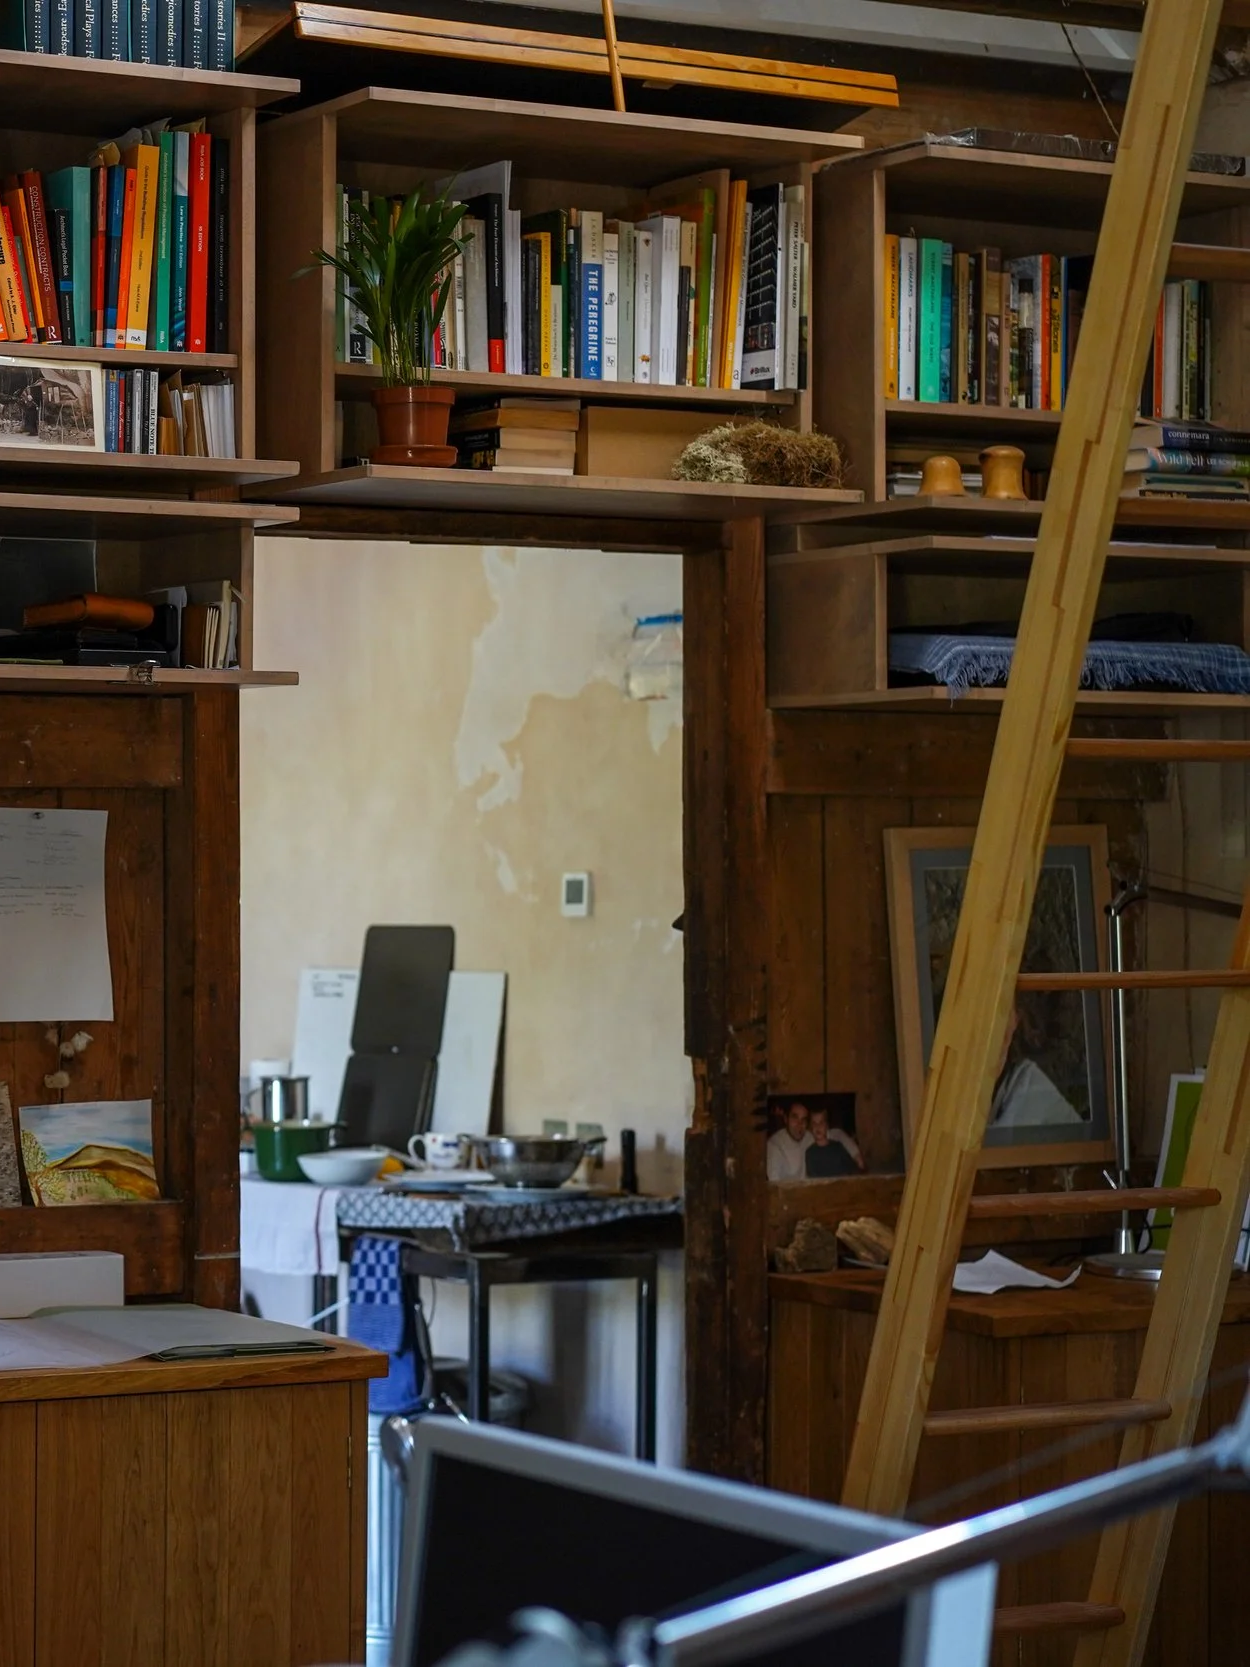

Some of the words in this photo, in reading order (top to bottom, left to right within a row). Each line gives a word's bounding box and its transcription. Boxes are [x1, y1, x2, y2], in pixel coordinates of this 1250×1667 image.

[110, 0, 118, 23] ances
[140, 0, 150, 22] edies
[192, 0, 201, 26] tories
[56, 17, 69, 56] kespeare
[81, 13, 95, 38] Plays
[217, 31, 226, 41] II
[59, 215, 67, 238] Architect's
[30, 184, 45, 245] CONSTRUCTION
[38, 245, 51, 292] CONTRACTS
[59, 237, 68, 249] Legal
[61, 249, 69, 264] Pocket
[587, 269, 598, 291] THE
[587, 296, 598, 362] PEREGRINE
[1167, 429, 1211, 441] connemara
[1156, 450, 1183, 465] Wild
